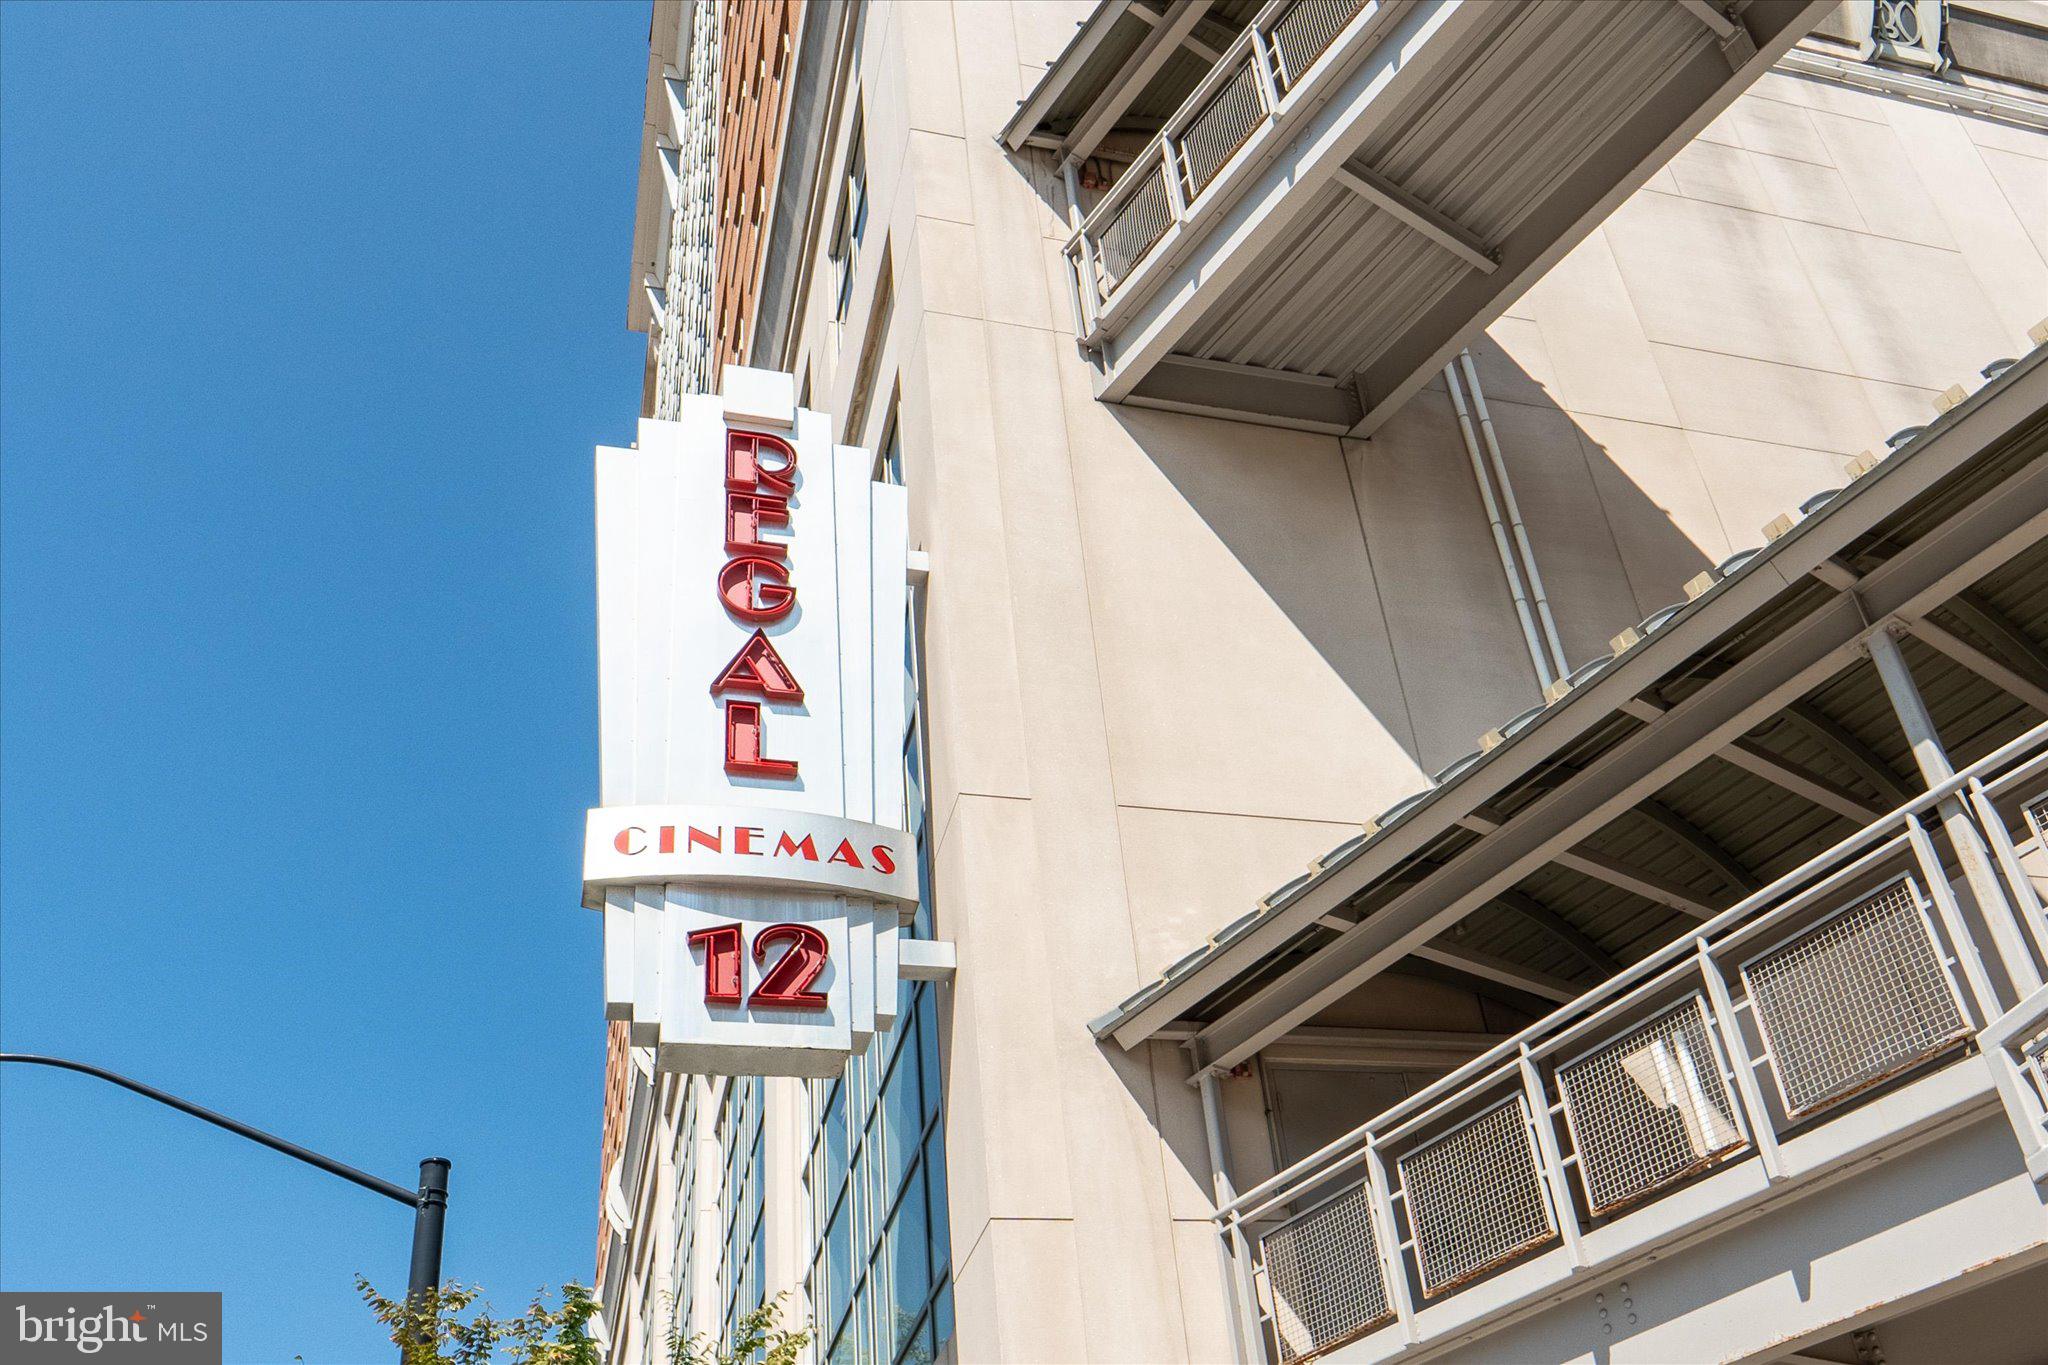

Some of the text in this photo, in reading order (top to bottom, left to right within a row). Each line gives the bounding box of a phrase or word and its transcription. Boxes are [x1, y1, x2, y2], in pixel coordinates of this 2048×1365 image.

[709, 428, 805, 780] REGAL
[613, 825, 897, 875] CINEMAS
[686, 922, 829, 1009] 12
